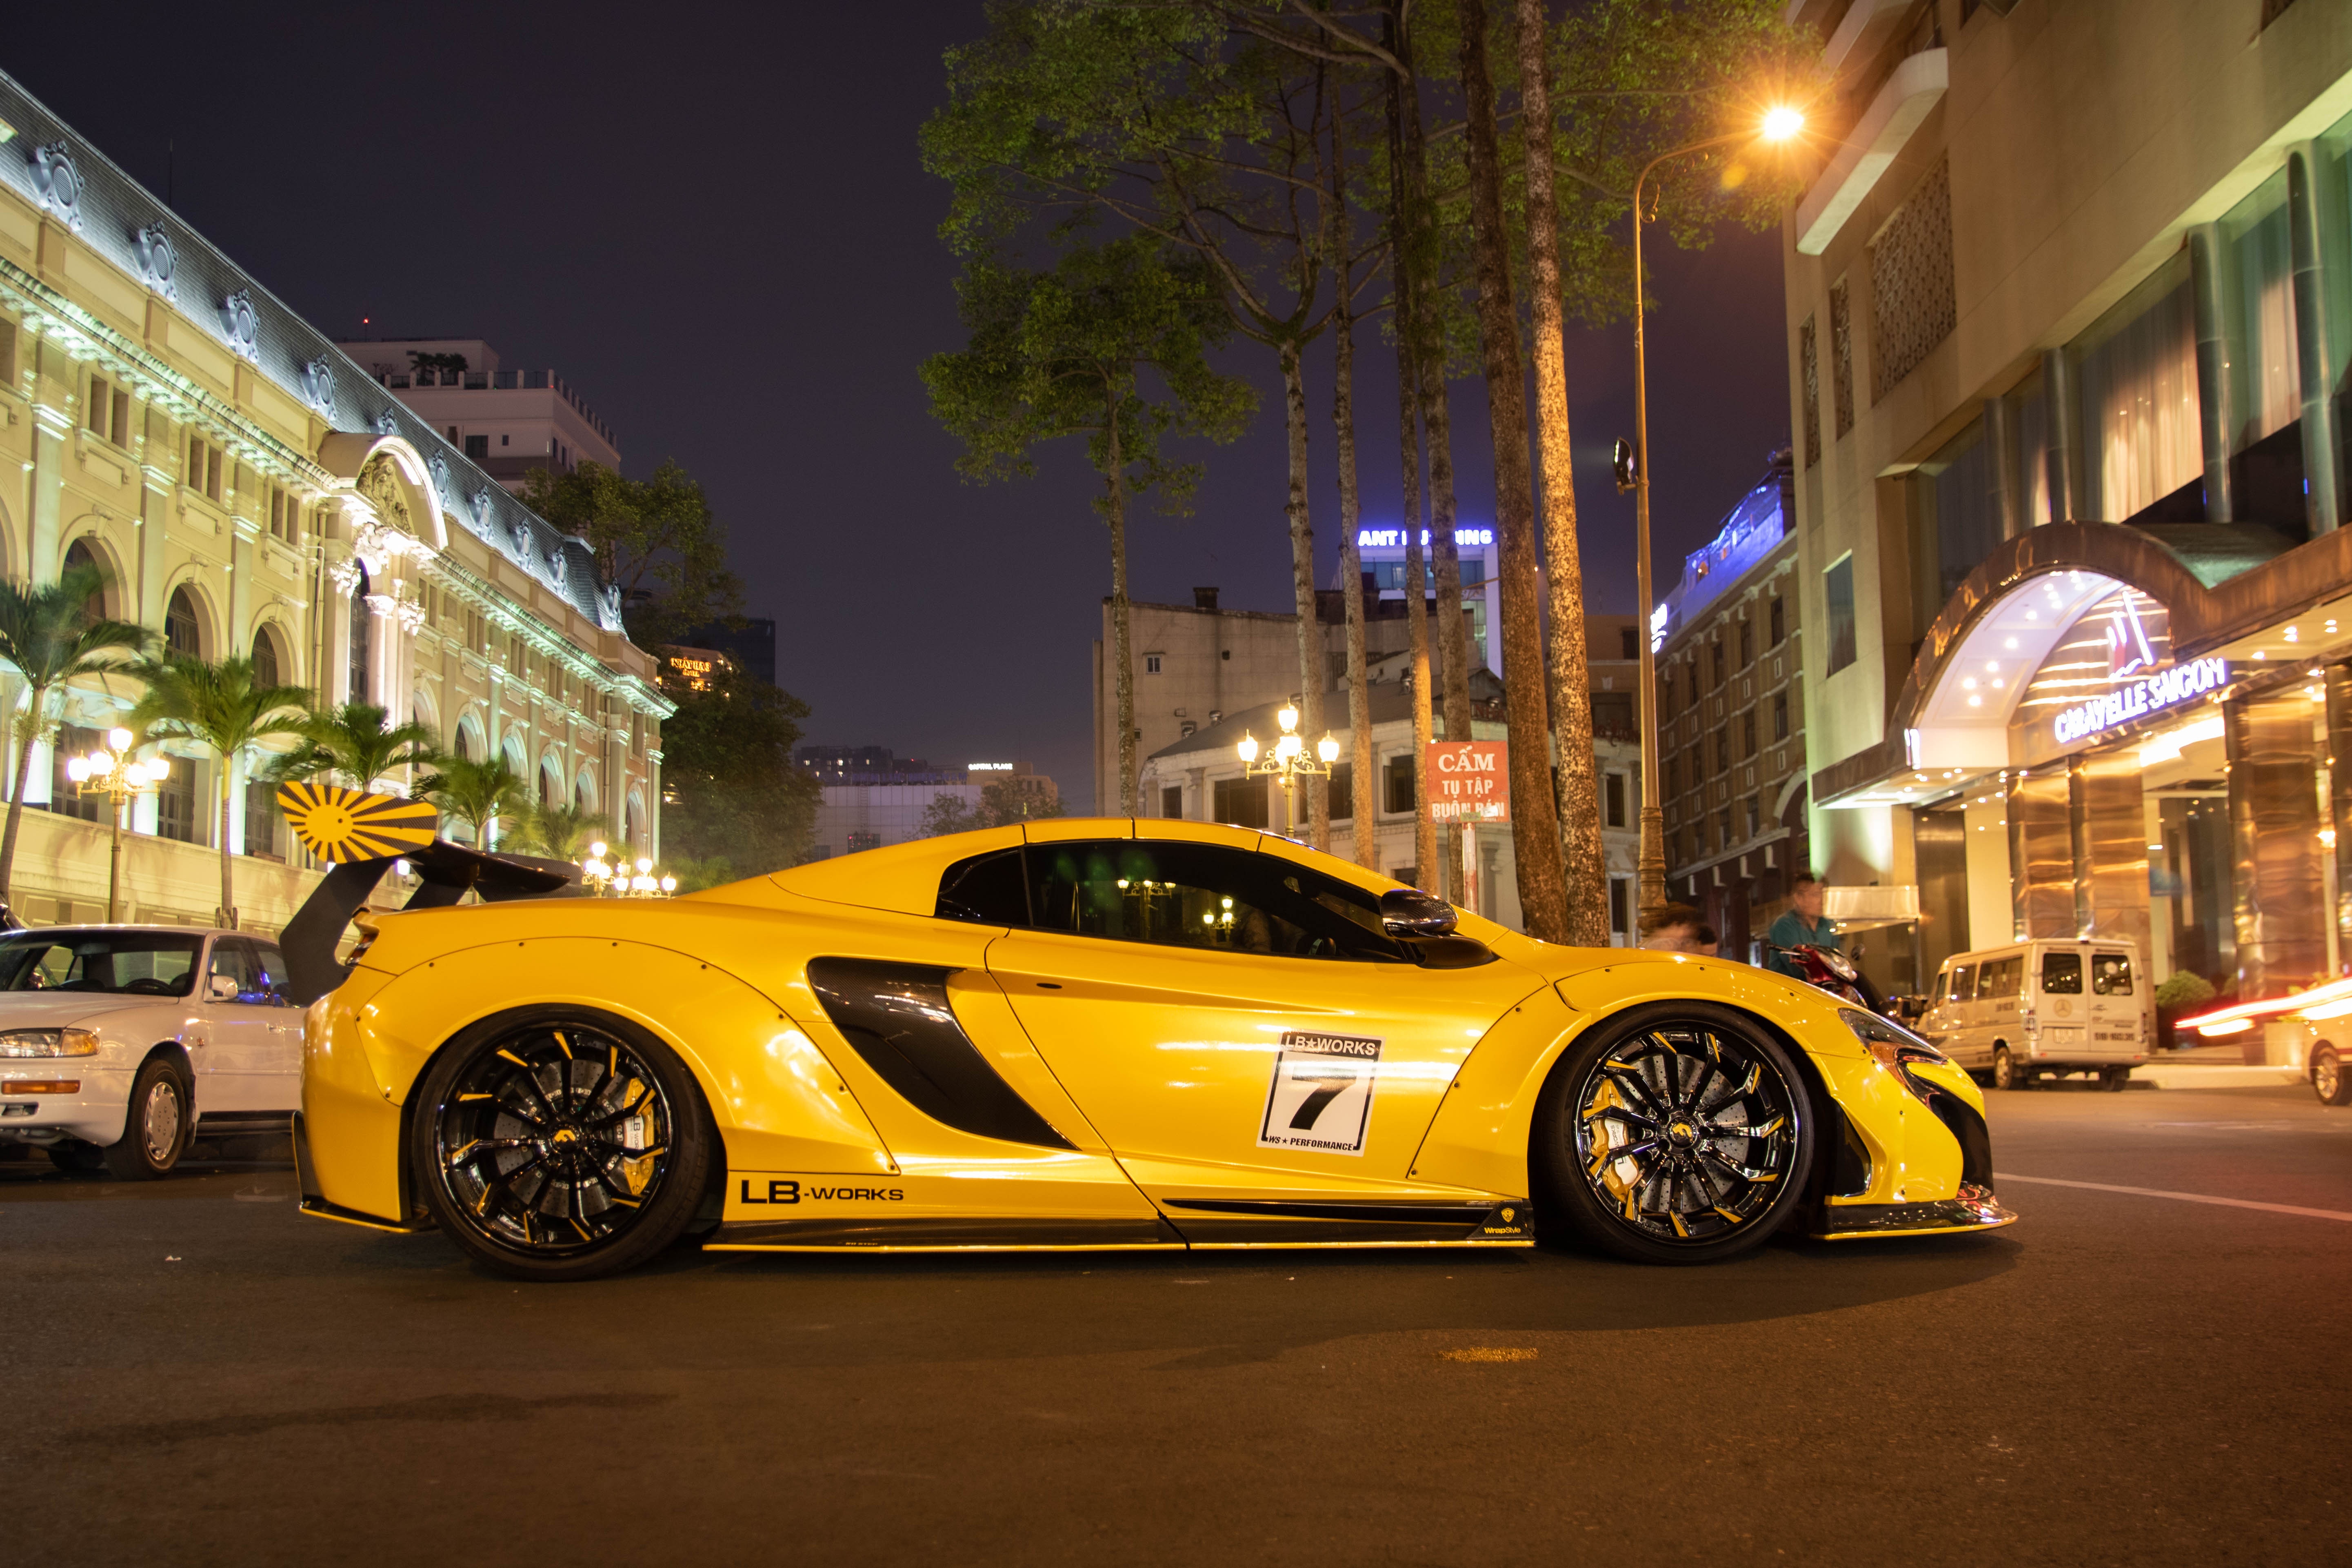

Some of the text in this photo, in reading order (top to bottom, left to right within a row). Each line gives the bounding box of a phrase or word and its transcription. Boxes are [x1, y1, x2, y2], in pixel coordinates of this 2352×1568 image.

[1358, 530, 1398, 546] ANT
[2054, 658, 2225, 744] CARAVELLE SAIGON
[1438, 745, 1495, 772] CẤM
[1442, 777, 1493, 798] TỤ TẬP
[1432, 800, 1471, 818] BUÔN
[1288, 1066, 1358, 1131] 7
[1268, 1135, 1353, 1151] WS PERFORMANCE
